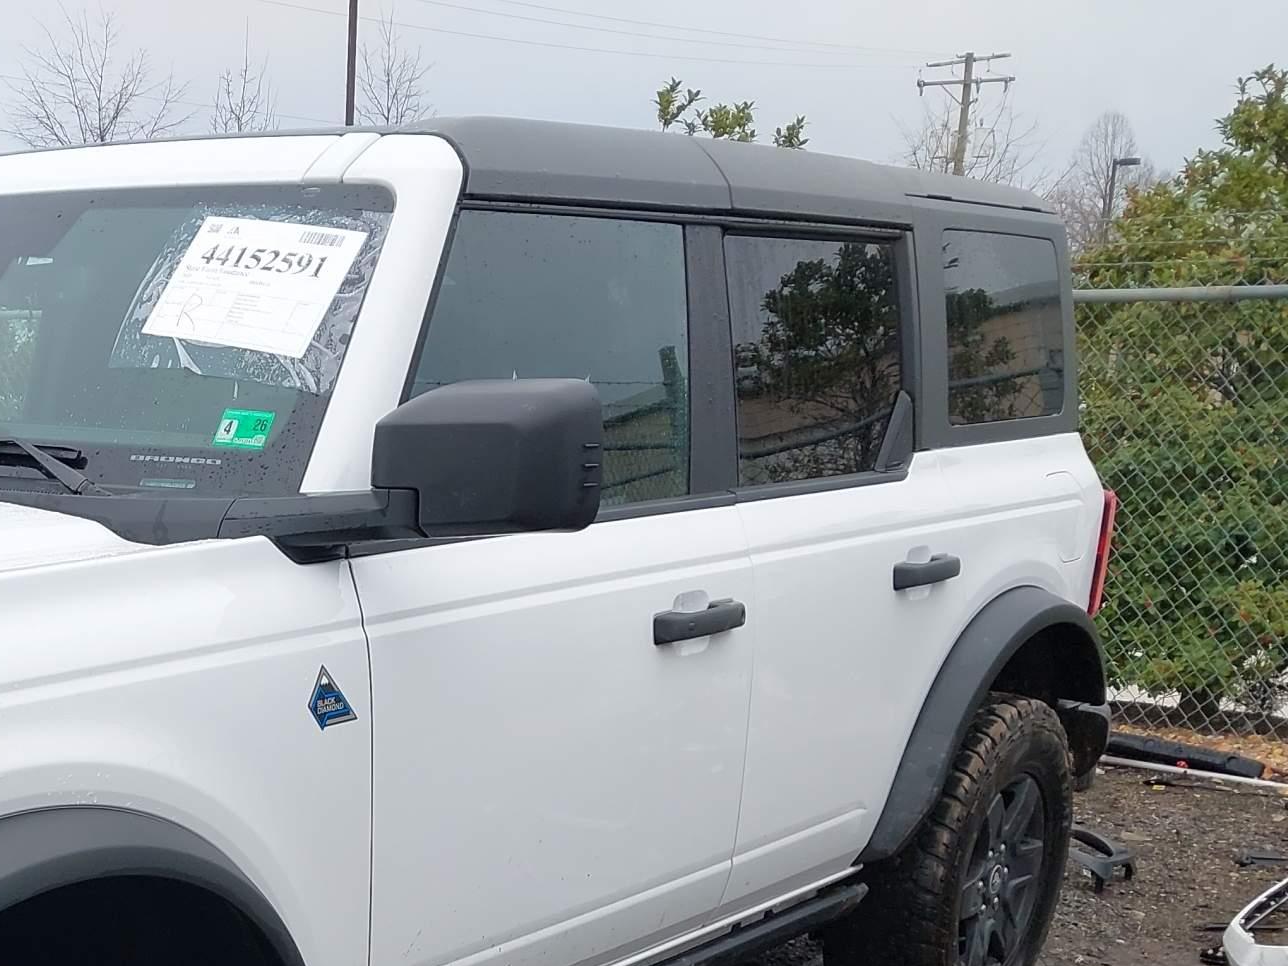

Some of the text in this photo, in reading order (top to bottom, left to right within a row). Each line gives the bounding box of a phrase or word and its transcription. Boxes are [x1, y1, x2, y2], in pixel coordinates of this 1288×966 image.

[201, 243, 328, 278] 44152591
[224, 418, 268, 434] 4 26
[130, 455, 222, 464] BRONCO
[317, 696, 335, 707] BLACK
[317, 702, 344, 714] DIAMOND
